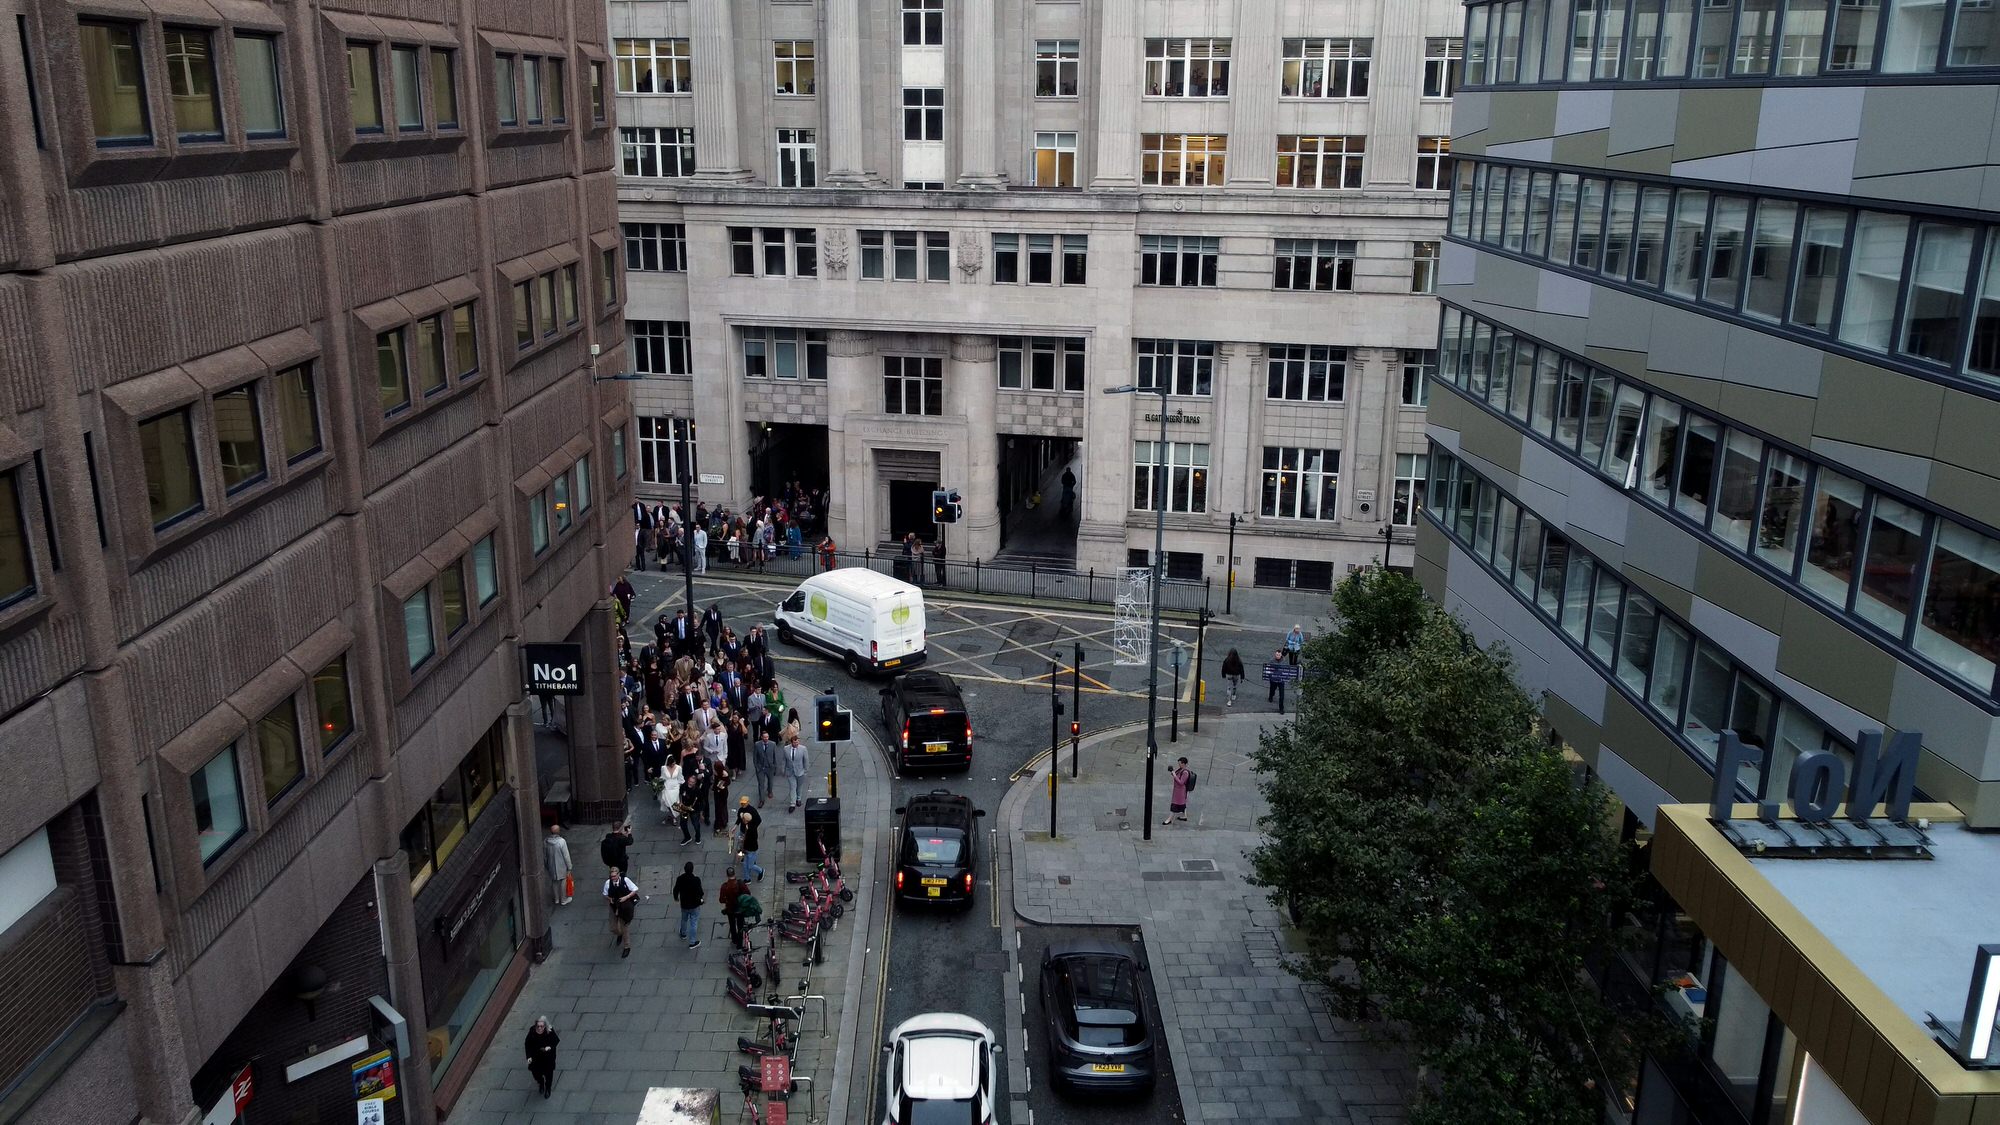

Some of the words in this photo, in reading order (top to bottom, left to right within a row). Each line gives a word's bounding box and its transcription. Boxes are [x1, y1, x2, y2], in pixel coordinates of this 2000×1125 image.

[1183, 416, 1200, 424] TAPAS
[533, 663, 577, 681] No1
[535, 682, 578, 690] TITHEBARN
